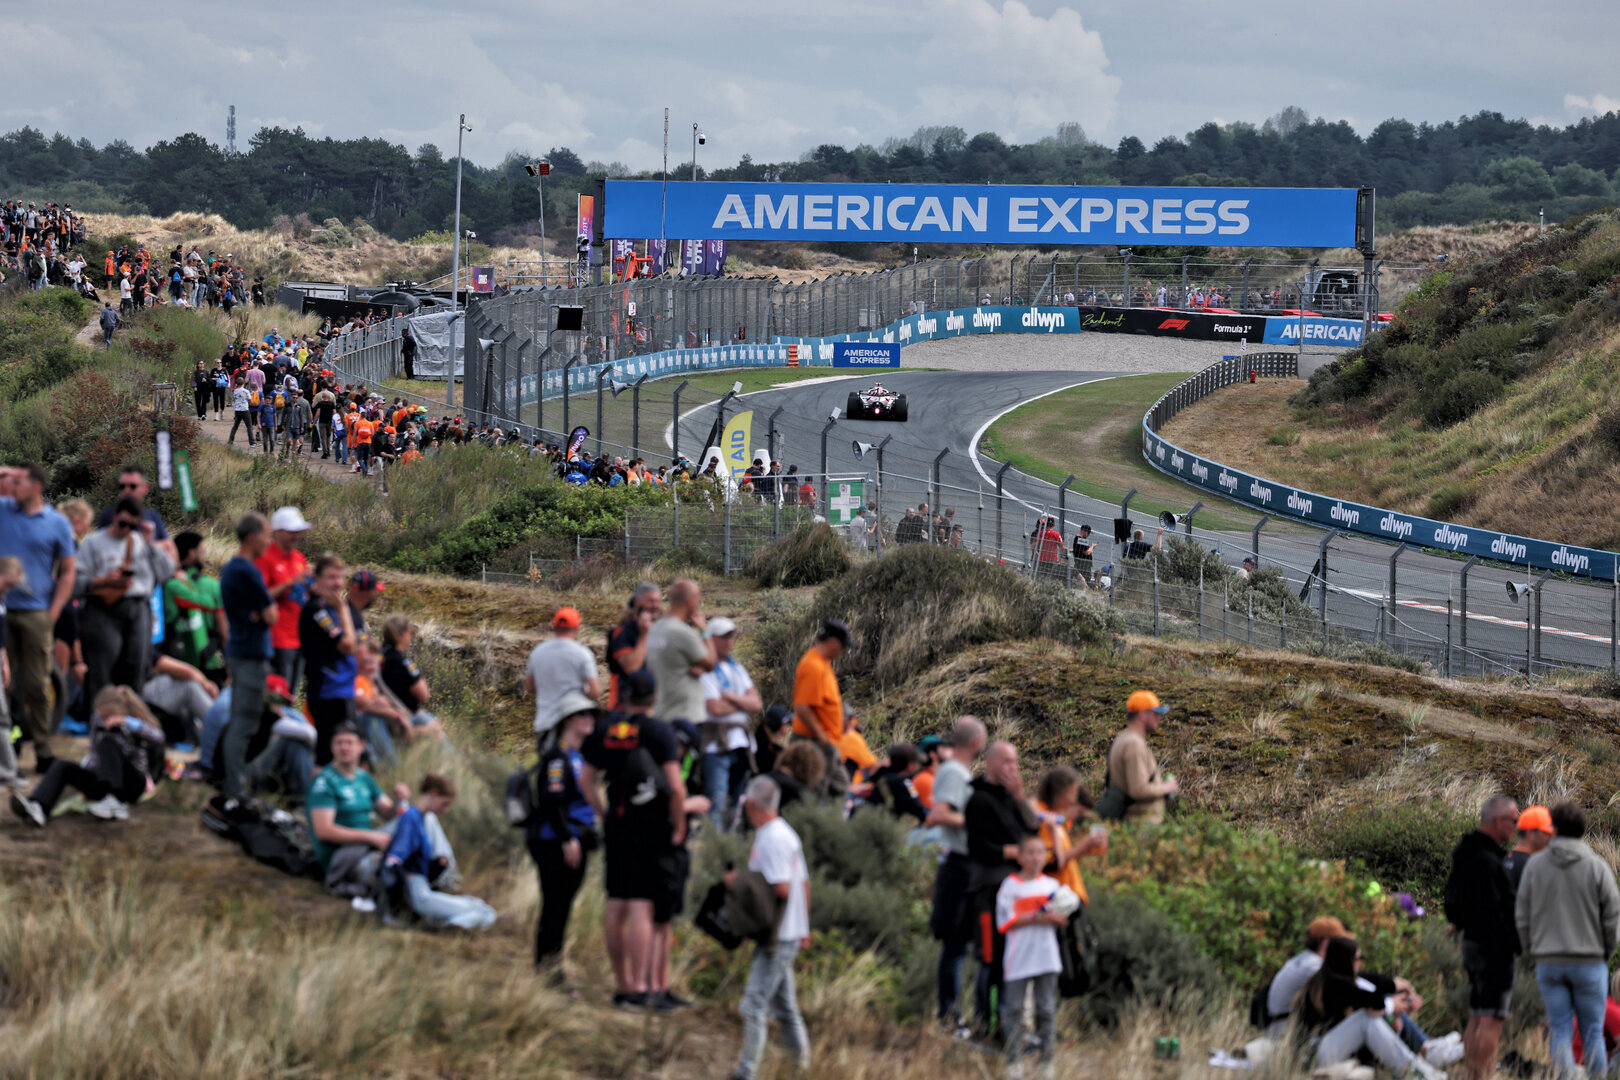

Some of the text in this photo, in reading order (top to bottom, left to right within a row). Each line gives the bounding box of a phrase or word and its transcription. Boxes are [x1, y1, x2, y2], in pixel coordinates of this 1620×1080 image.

[712, 194, 1250, 235] AMERICAN EXPRESS
[973, 308, 1001, 332] allwyn
[1022, 308, 1064, 332] allwyn
[1214, 323, 1242, 334] Formula
[1280, 324, 1362, 341] AMERICAN
[844, 349, 890, 357] AMERICAN
[850, 356, 891, 364] EXPRESS
[570, 435, 585, 454] INFO
[731, 430, 745, 462] AID
[1219, 468, 1238, 493] allwyn
[1250, 479, 1272, 504] allwyn
[1287, 491, 1313, 517] allwyn
[1330, 502, 1360, 527] allwyn
[1380, 513, 1413, 539] allwyn
[1434, 525, 1468, 550] allwyn
[1491, 535, 1527, 561] allwyn
[1551, 546, 1589, 573] allwyn
